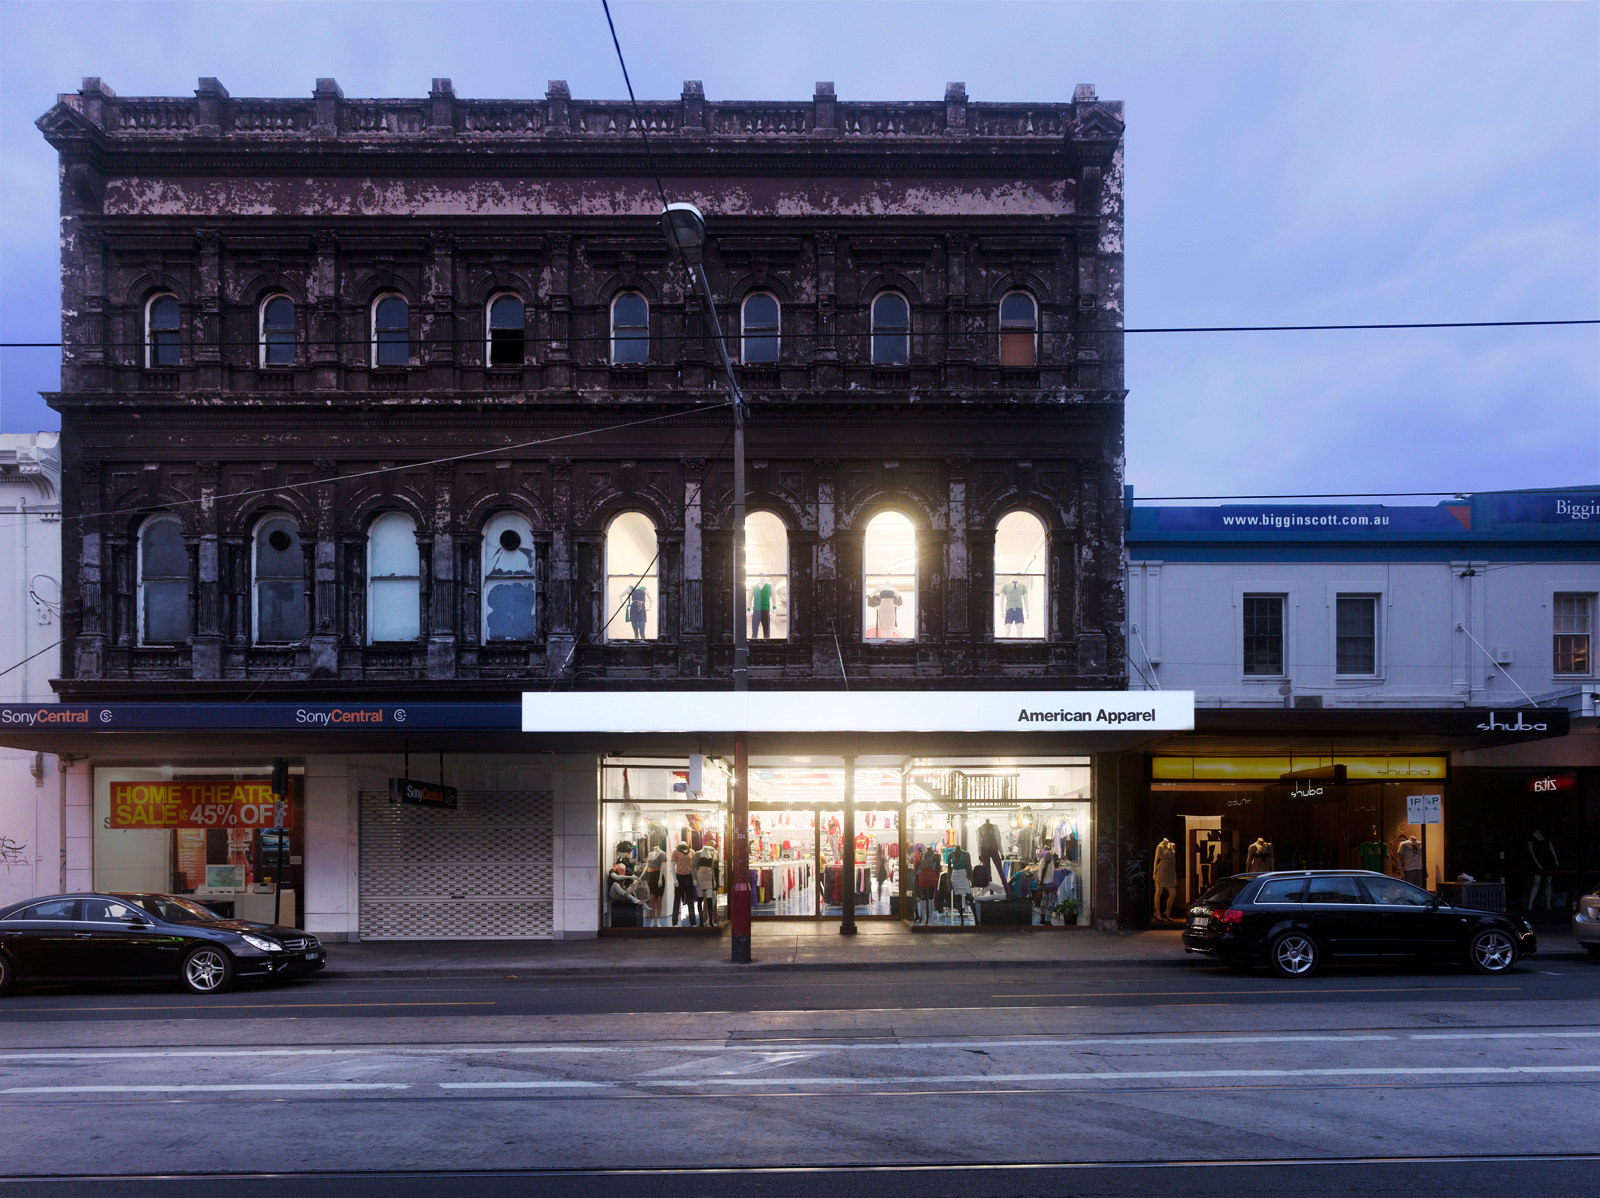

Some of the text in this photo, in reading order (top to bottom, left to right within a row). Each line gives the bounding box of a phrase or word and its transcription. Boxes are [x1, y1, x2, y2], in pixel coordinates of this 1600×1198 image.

[1223, 514, 1390, 529] www.bigginscott.com.au
[1017, 708, 1156, 725] American Apparel
[1476, 711, 1547, 731] shuba
[1377, 759, 1430, 776] shuba
[116, 785, 182, 804] HOME
[1290, 778, 1323, 798] shuba
[116, 804, 178, 825] SALE
[189, 804, 238, 825] 45%
